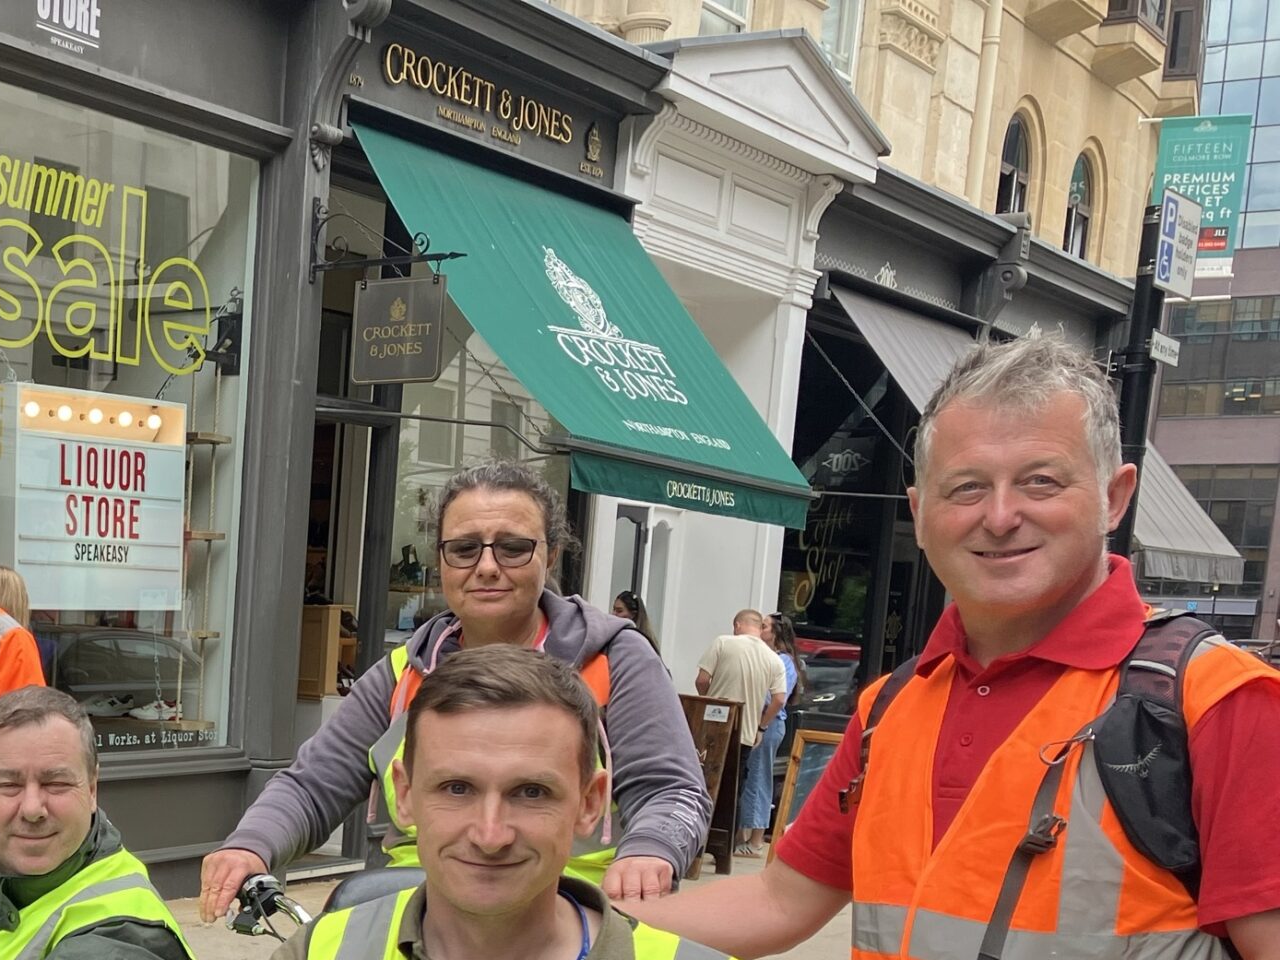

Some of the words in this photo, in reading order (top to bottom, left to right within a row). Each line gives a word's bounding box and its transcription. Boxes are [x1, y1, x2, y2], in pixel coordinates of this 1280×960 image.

[385, 43, 496, 113] CROCKETT
[499, 89, 512, 119] &
[513, 95, 573, 144] JONES
[438, 105, 486, 133] NORTHAMPTON
[491, 126, 522, 145] ENGLAND
[1173, 142, 1233, 154] FIFTEEN
[1164, 171, 1236, 184] PREMIUM
[1220, 207, 1232, 218] ft
[363, 322, 432, 342] CROCKETT
[379, 341, 422, 358] JONES
[557, 333, 676, 378] CROCKETT
[594, 365, 620, 392] &
[614, 368, 688, 405] JONES
[59, 443, 147, 492] LIQUOR
[64, 494, 141, 540] STORE
[74, 542, 129, 563] SPEAKEASY
[794, 546, 846, 612] Shop
[108, 733, 140, 746] Works.
[144, 731, 156, 744] at
[161, 730, 194, 748] Liquor
